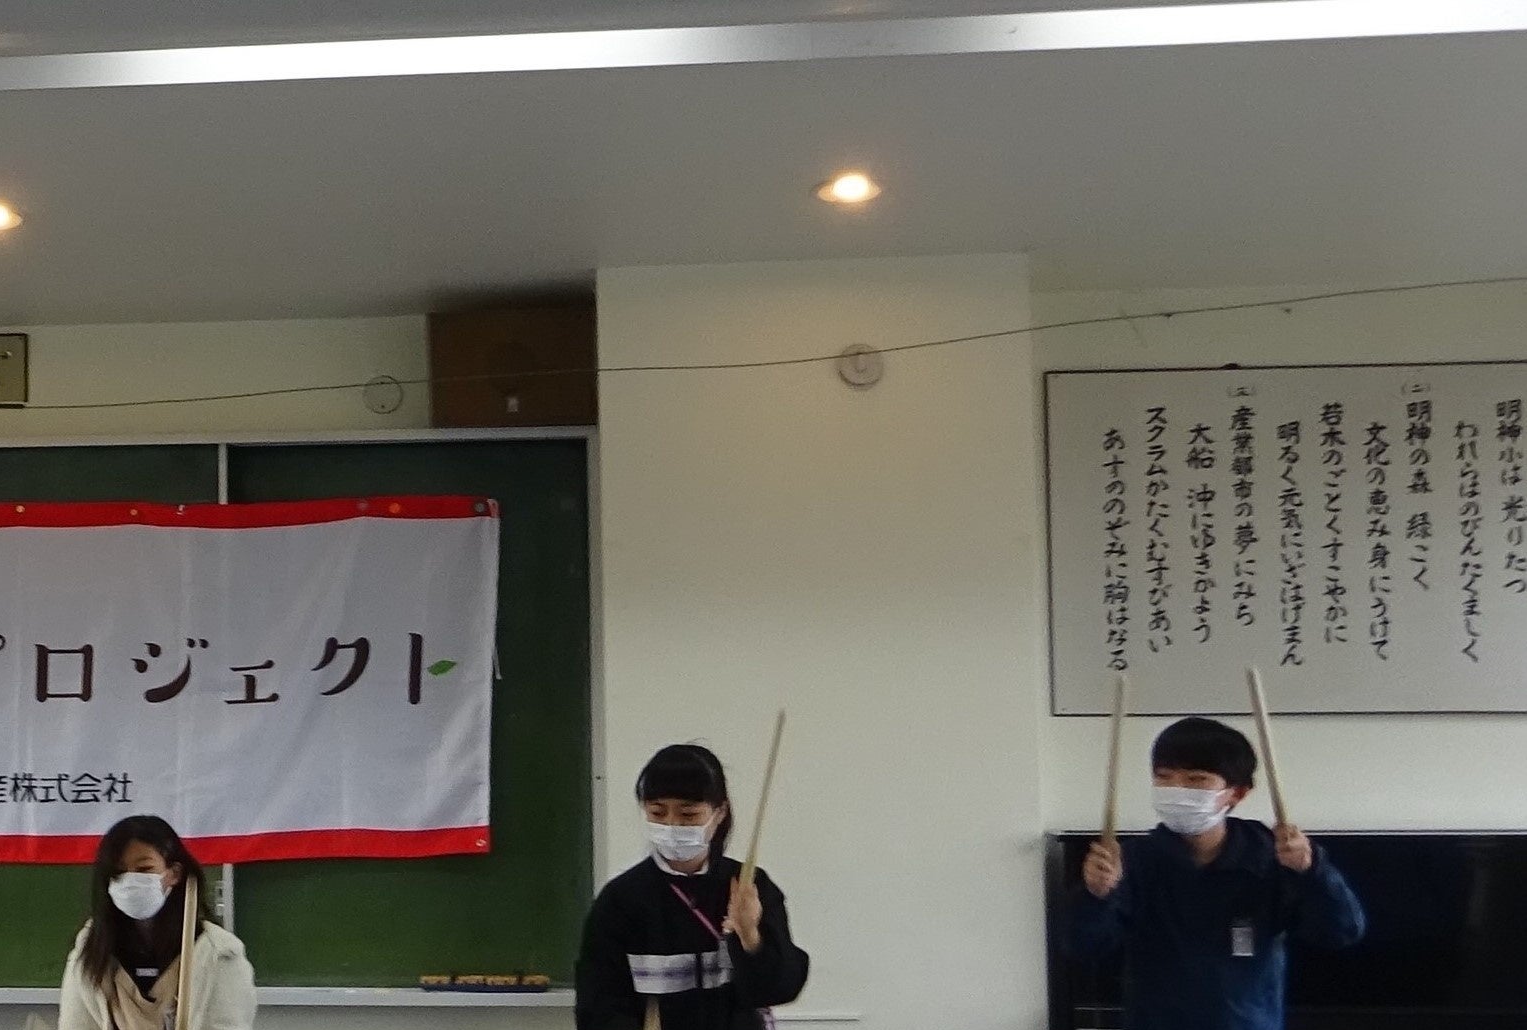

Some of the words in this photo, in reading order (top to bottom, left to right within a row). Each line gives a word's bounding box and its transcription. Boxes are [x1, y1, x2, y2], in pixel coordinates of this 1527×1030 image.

[1145, 406, 1173, 654] スクラムかたくむすびあい
[1185, 422, 1215, 470] 大船
[1319, 402, 1349, 644] 若木のごとくすこやかに
[1363, 421, 1392, 662] 文化の恵み身にうけて
